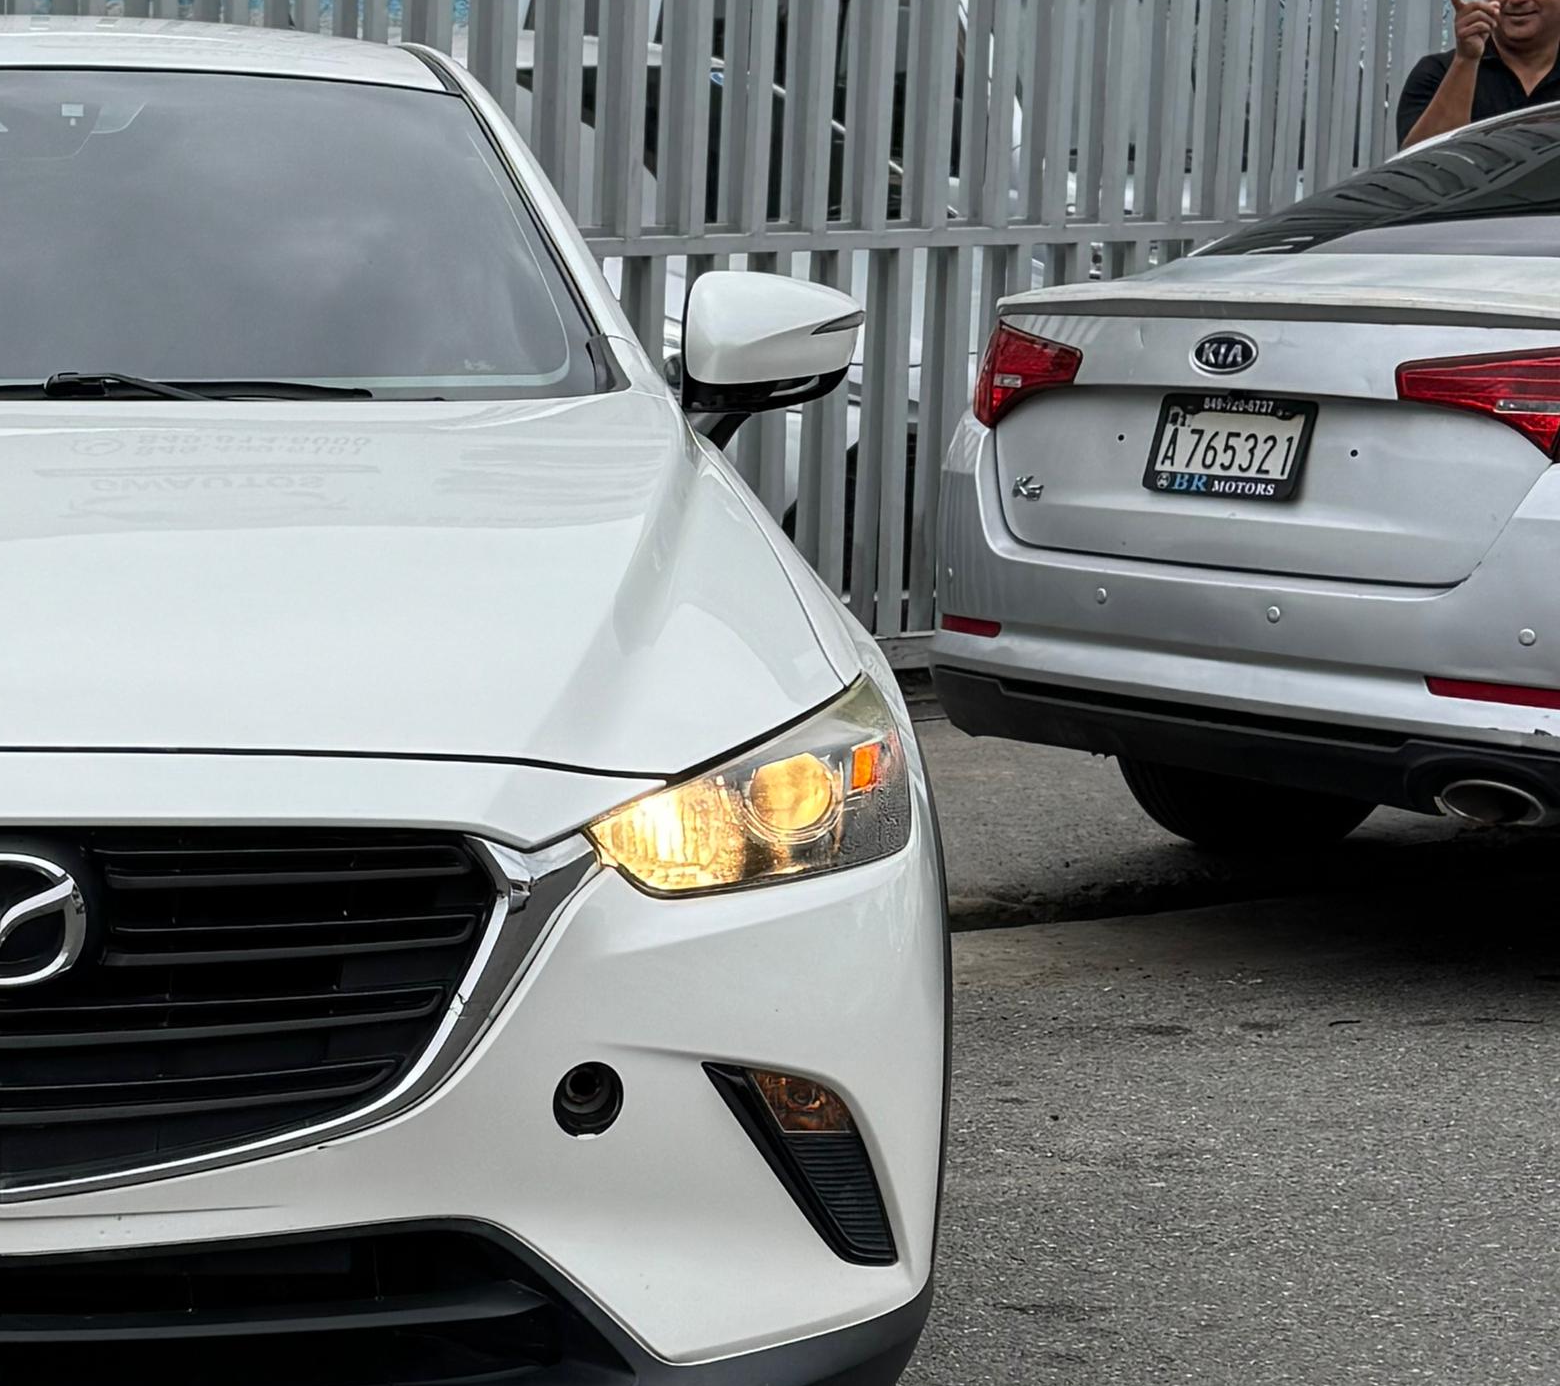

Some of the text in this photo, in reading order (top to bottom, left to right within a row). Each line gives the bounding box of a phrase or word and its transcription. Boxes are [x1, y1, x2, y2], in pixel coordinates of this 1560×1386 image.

[1201, 342, 1243, 365] KIA
[1171, 473, 1276, 497] BR MOTORS
